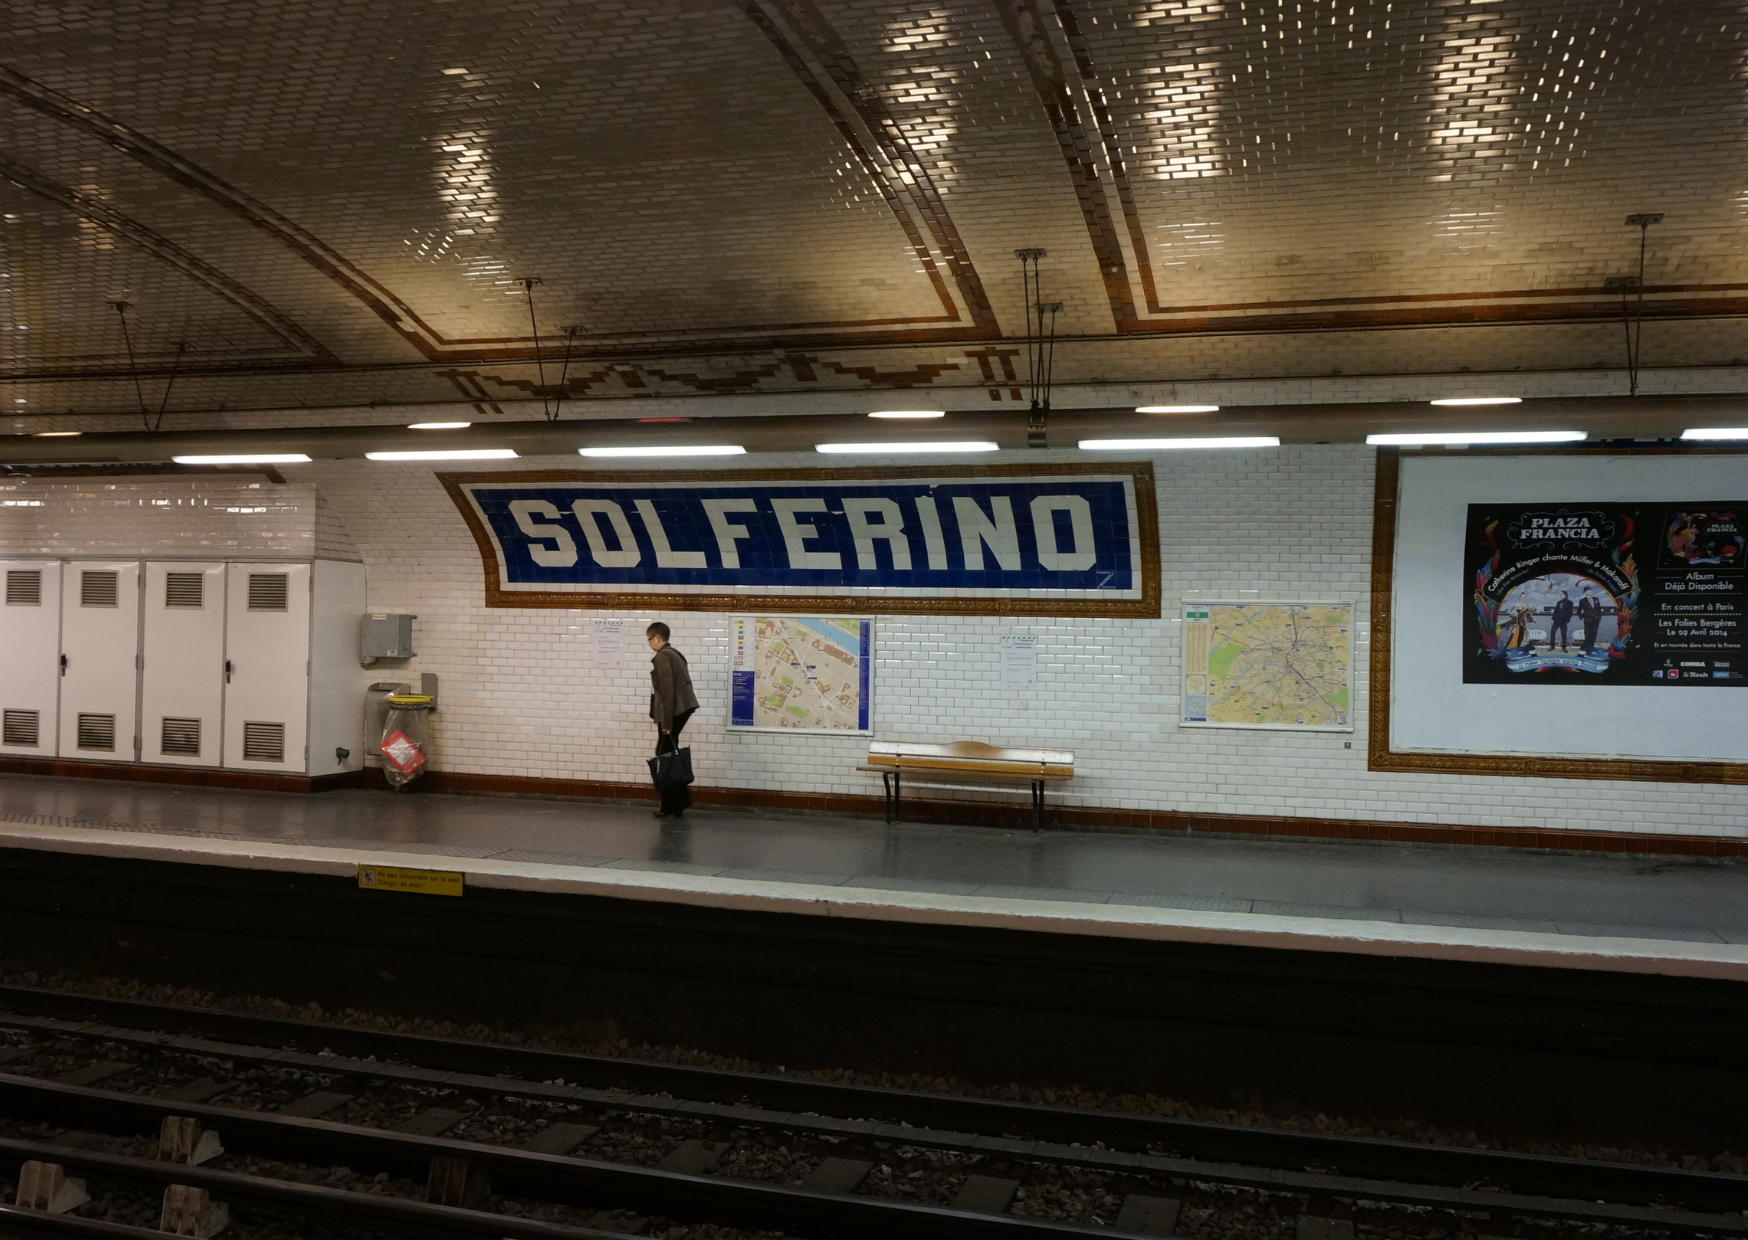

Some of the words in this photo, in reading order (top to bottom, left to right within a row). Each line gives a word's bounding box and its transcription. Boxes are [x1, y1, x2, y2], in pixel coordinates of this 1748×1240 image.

[1531, 518, 1591, 528] PLAZA
[507, 495, 1097, 572] SOLFERINO
[1520, 529, 1600, 539] FRANCIA
[1487, 567, 1516, 592] Catherine
[1516, 557, 1540, 569] Ringer
[1542, 553, 1568, 562] chante
[1570, 554, 1594, 565] Müller
[1600, 564, 1630, 590] Makaroff
[1665, 582, 1686, 591] Déjà
[1688, 581, 1734, 591] Disponible
[1674, 618, 1697, 626] Folies
[1700, 619, 1737, 628] Bergères
[1581, 660, 1598, 670] book
